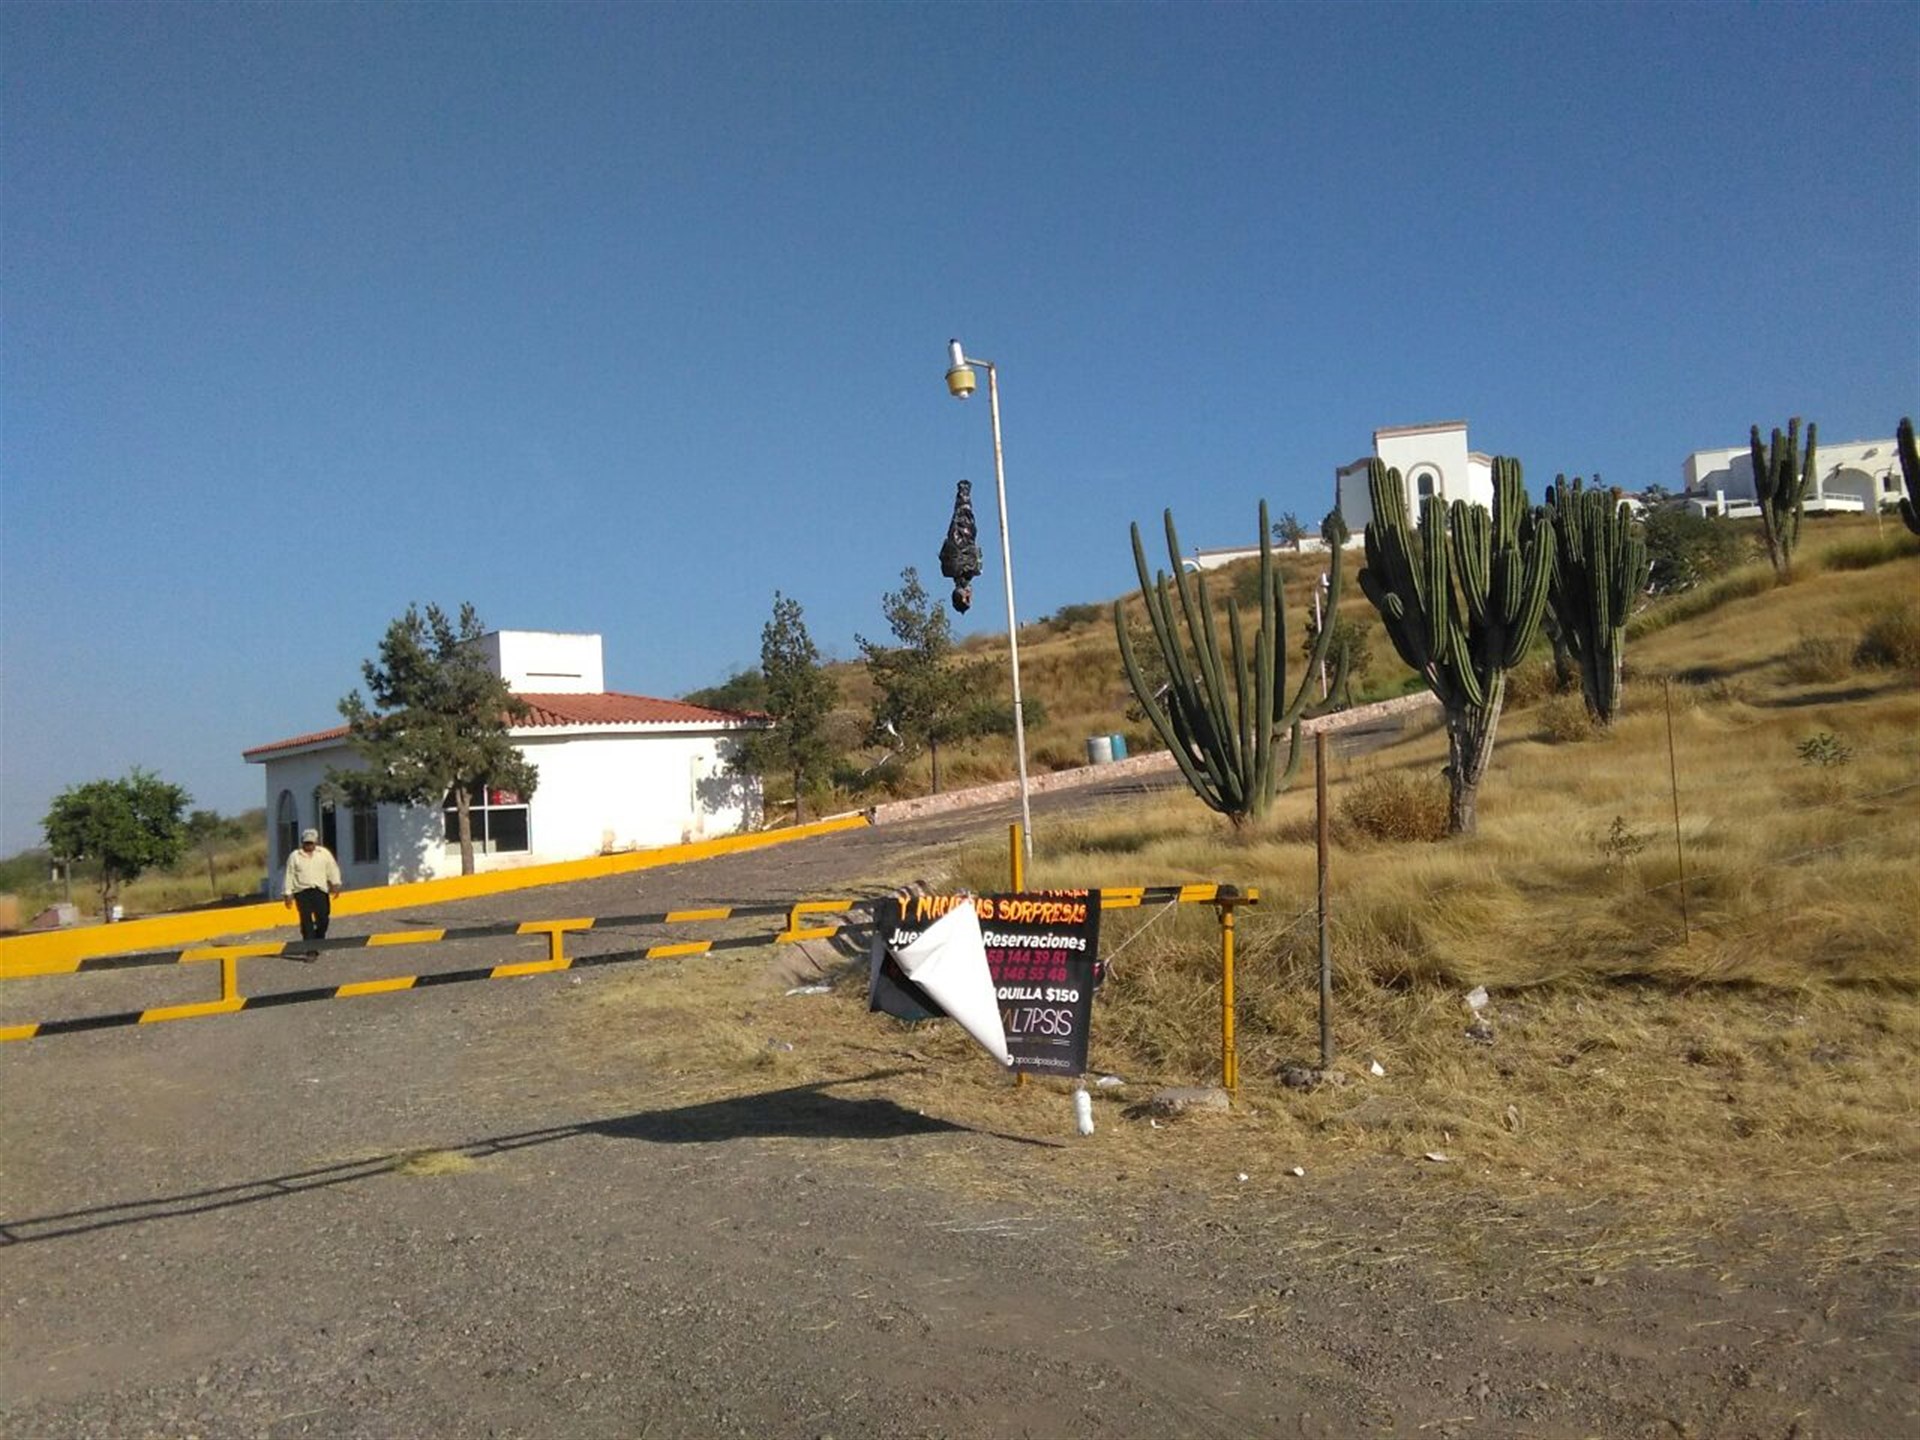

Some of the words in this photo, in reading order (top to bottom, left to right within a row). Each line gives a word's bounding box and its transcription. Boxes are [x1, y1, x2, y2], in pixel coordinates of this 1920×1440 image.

[897, 893, 911, 921] Y
[888, 928, 924, 945] Jue
[983, 930, 1086, 951] Reservaciones
[1045, 987, 1079, 1003] $150
